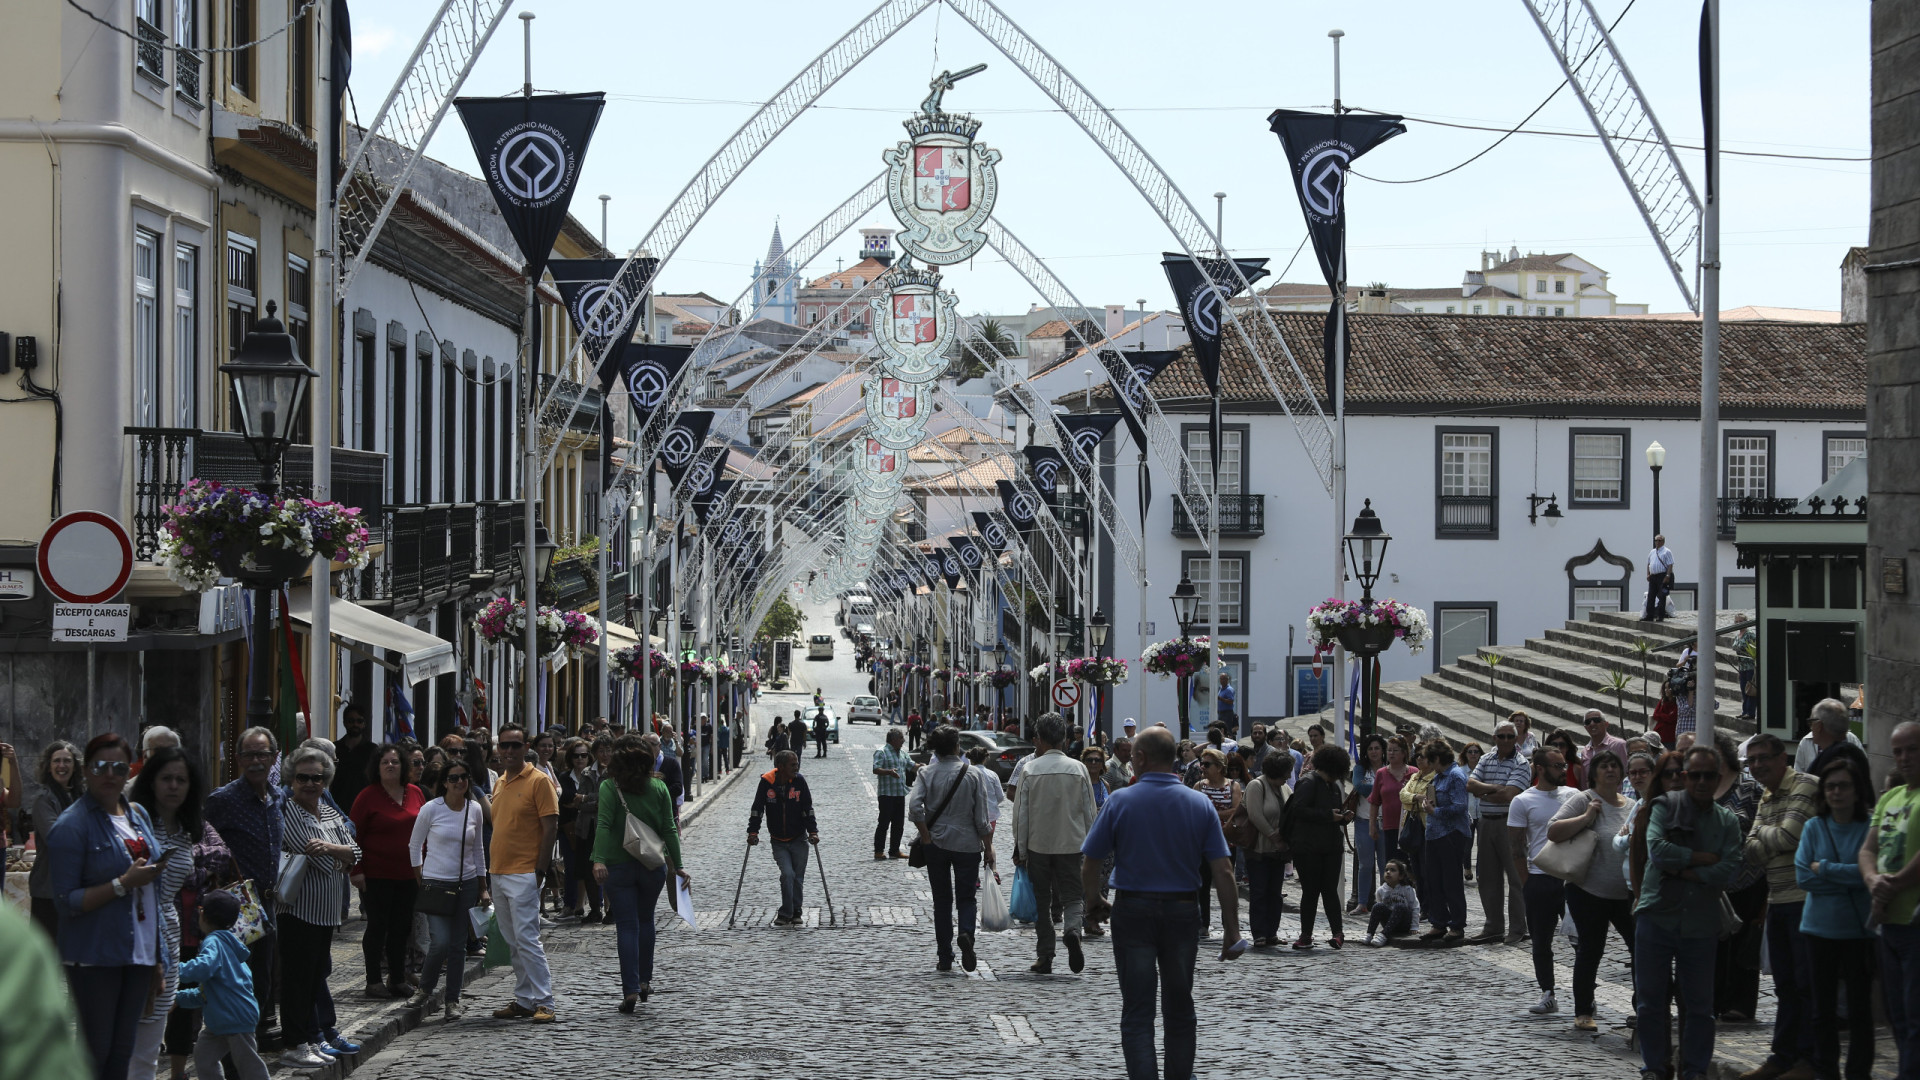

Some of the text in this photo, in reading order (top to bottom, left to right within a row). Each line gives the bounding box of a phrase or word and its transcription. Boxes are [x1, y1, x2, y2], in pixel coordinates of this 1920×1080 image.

[496, 121, 567, 146] PATRIMONIO MUNDIAL
[564, 151, 575, 188] MONDIAL
[489, 153, 522, 207] WOLRD HERITAGE
[901, 215, 916, 230] LEAL
[961, 225, 970, 234] DE
[924, 253, 961, 261] CONSTANTE
[55, 608, 128, 617] EXCEPTO CARGAS
[65, 629, 116, 637] DESCARGAS
